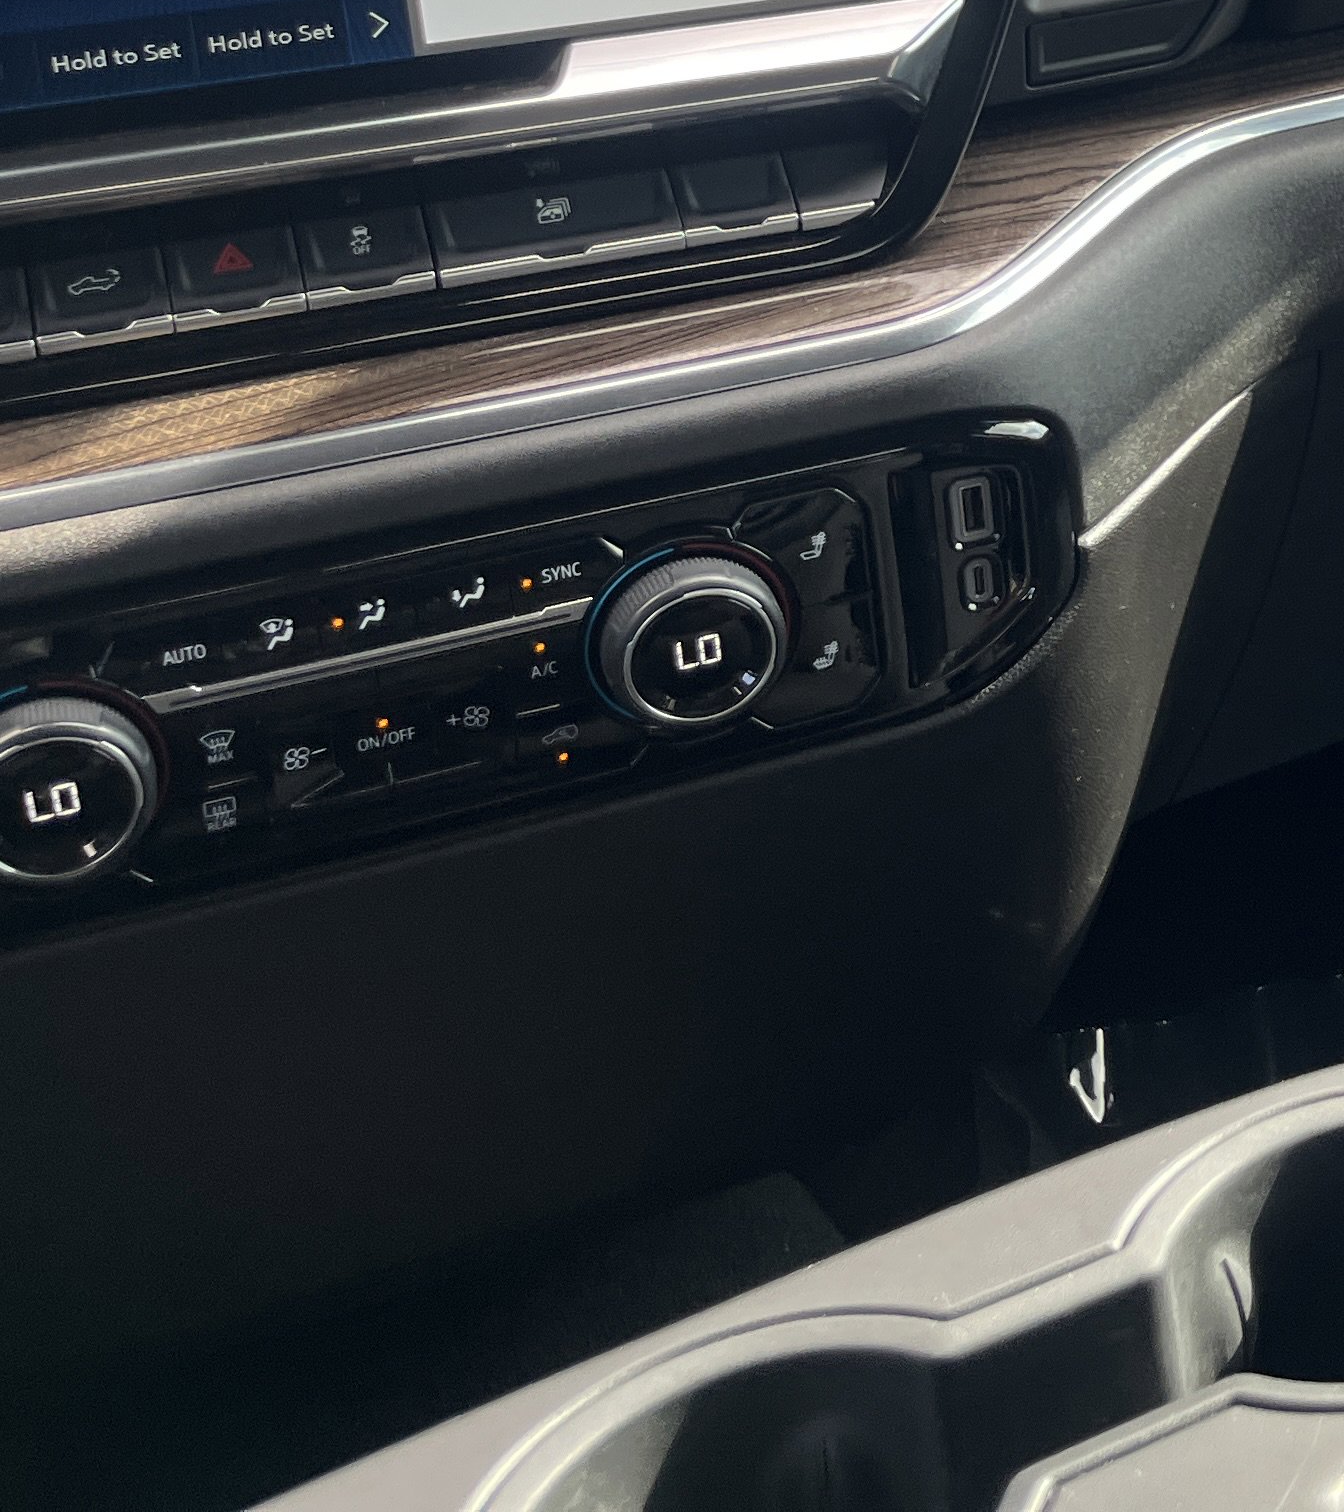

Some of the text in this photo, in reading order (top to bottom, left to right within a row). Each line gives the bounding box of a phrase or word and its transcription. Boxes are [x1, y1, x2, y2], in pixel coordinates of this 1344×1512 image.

[208, 23, 335, 54] Hold to Set
[51, 42, 182, 74] Hold to Set
[352, 243, 371, 256] OFF
[541, 561, 582, 584] SYNC
[163, 643, 207, 667] AUTO
[675, 632, 722, 670] LO
[531, 660, 560, 680] A/C
[357, 725, 416, 753] ON/OFF
[24, 781, 81, 823] LO
